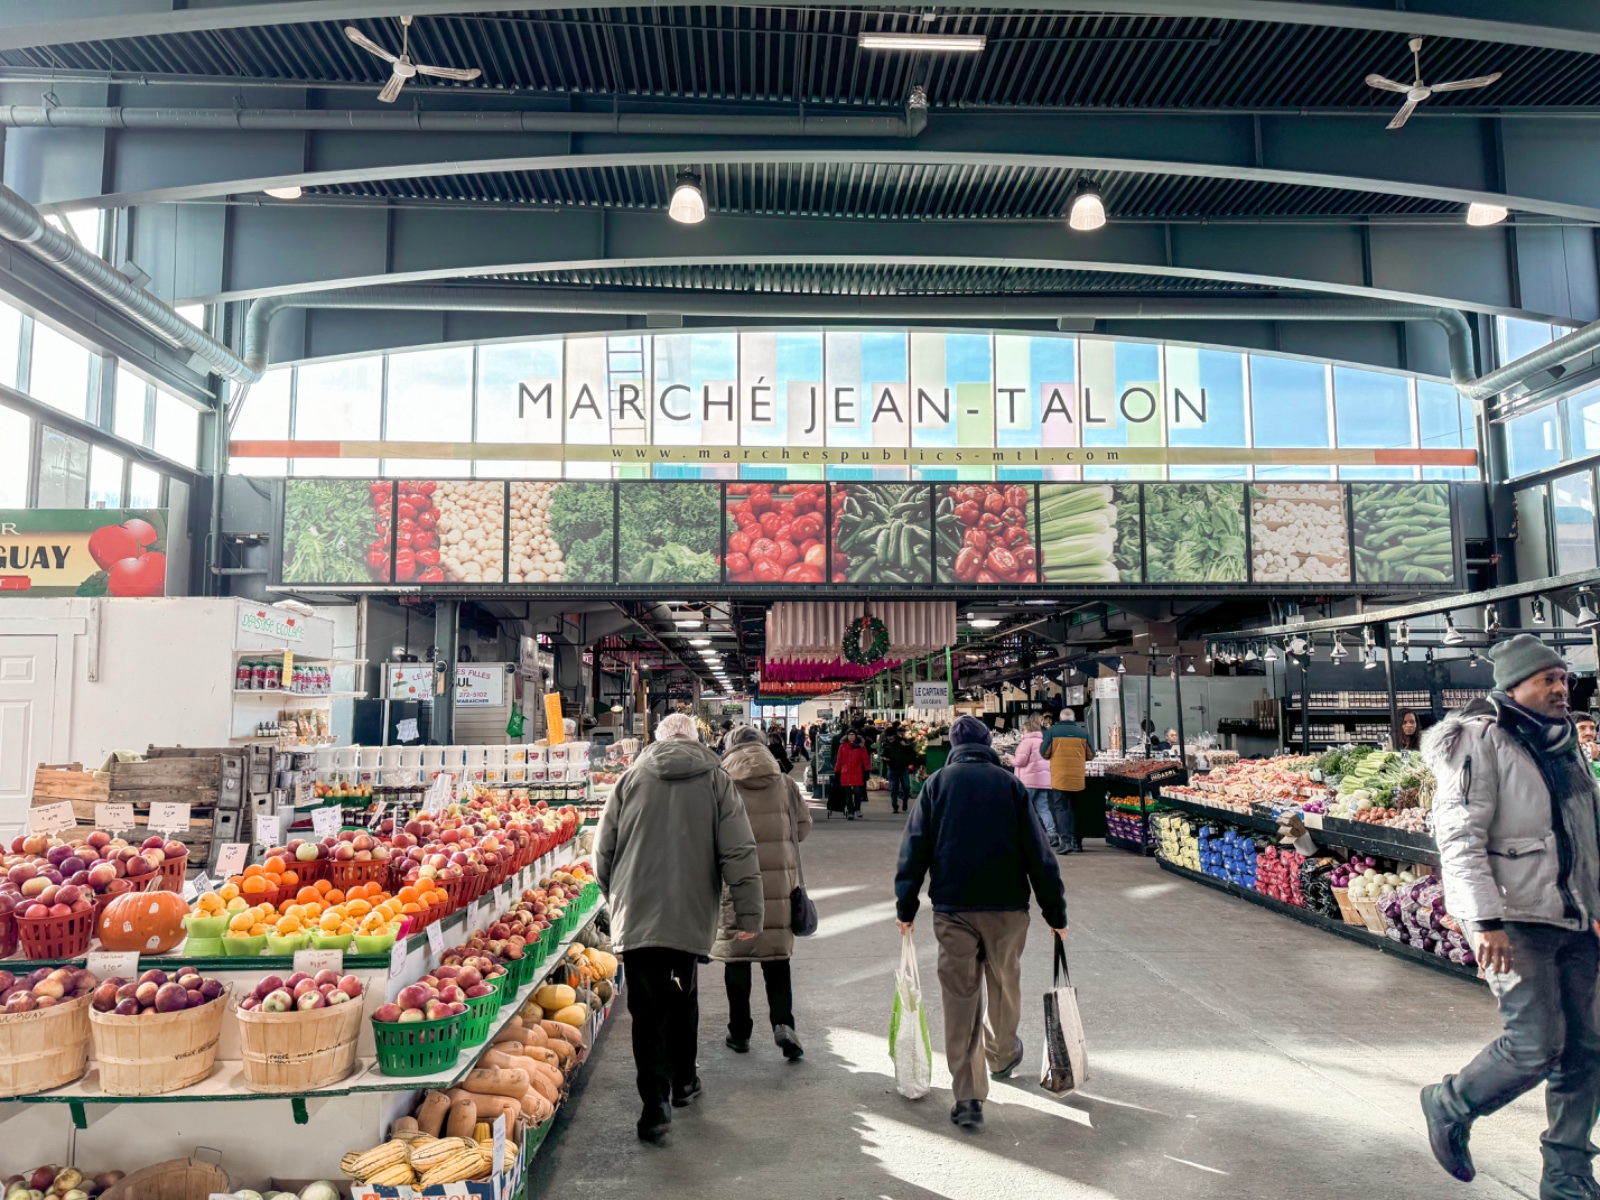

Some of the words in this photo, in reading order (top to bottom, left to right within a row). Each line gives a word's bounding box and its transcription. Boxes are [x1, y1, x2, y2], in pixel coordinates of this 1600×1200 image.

[518, 376, 772, 422] MARCHÉ
[804, 386, 1208, 435] JEAN-TALON
[612, 447, 1119, 463] www.marchespublics-mtl.com
[468, 669, 492, 679] FILLES
[915, 687, 922, 697] LE
[922, 687, 948, 697] CAPITAINE
